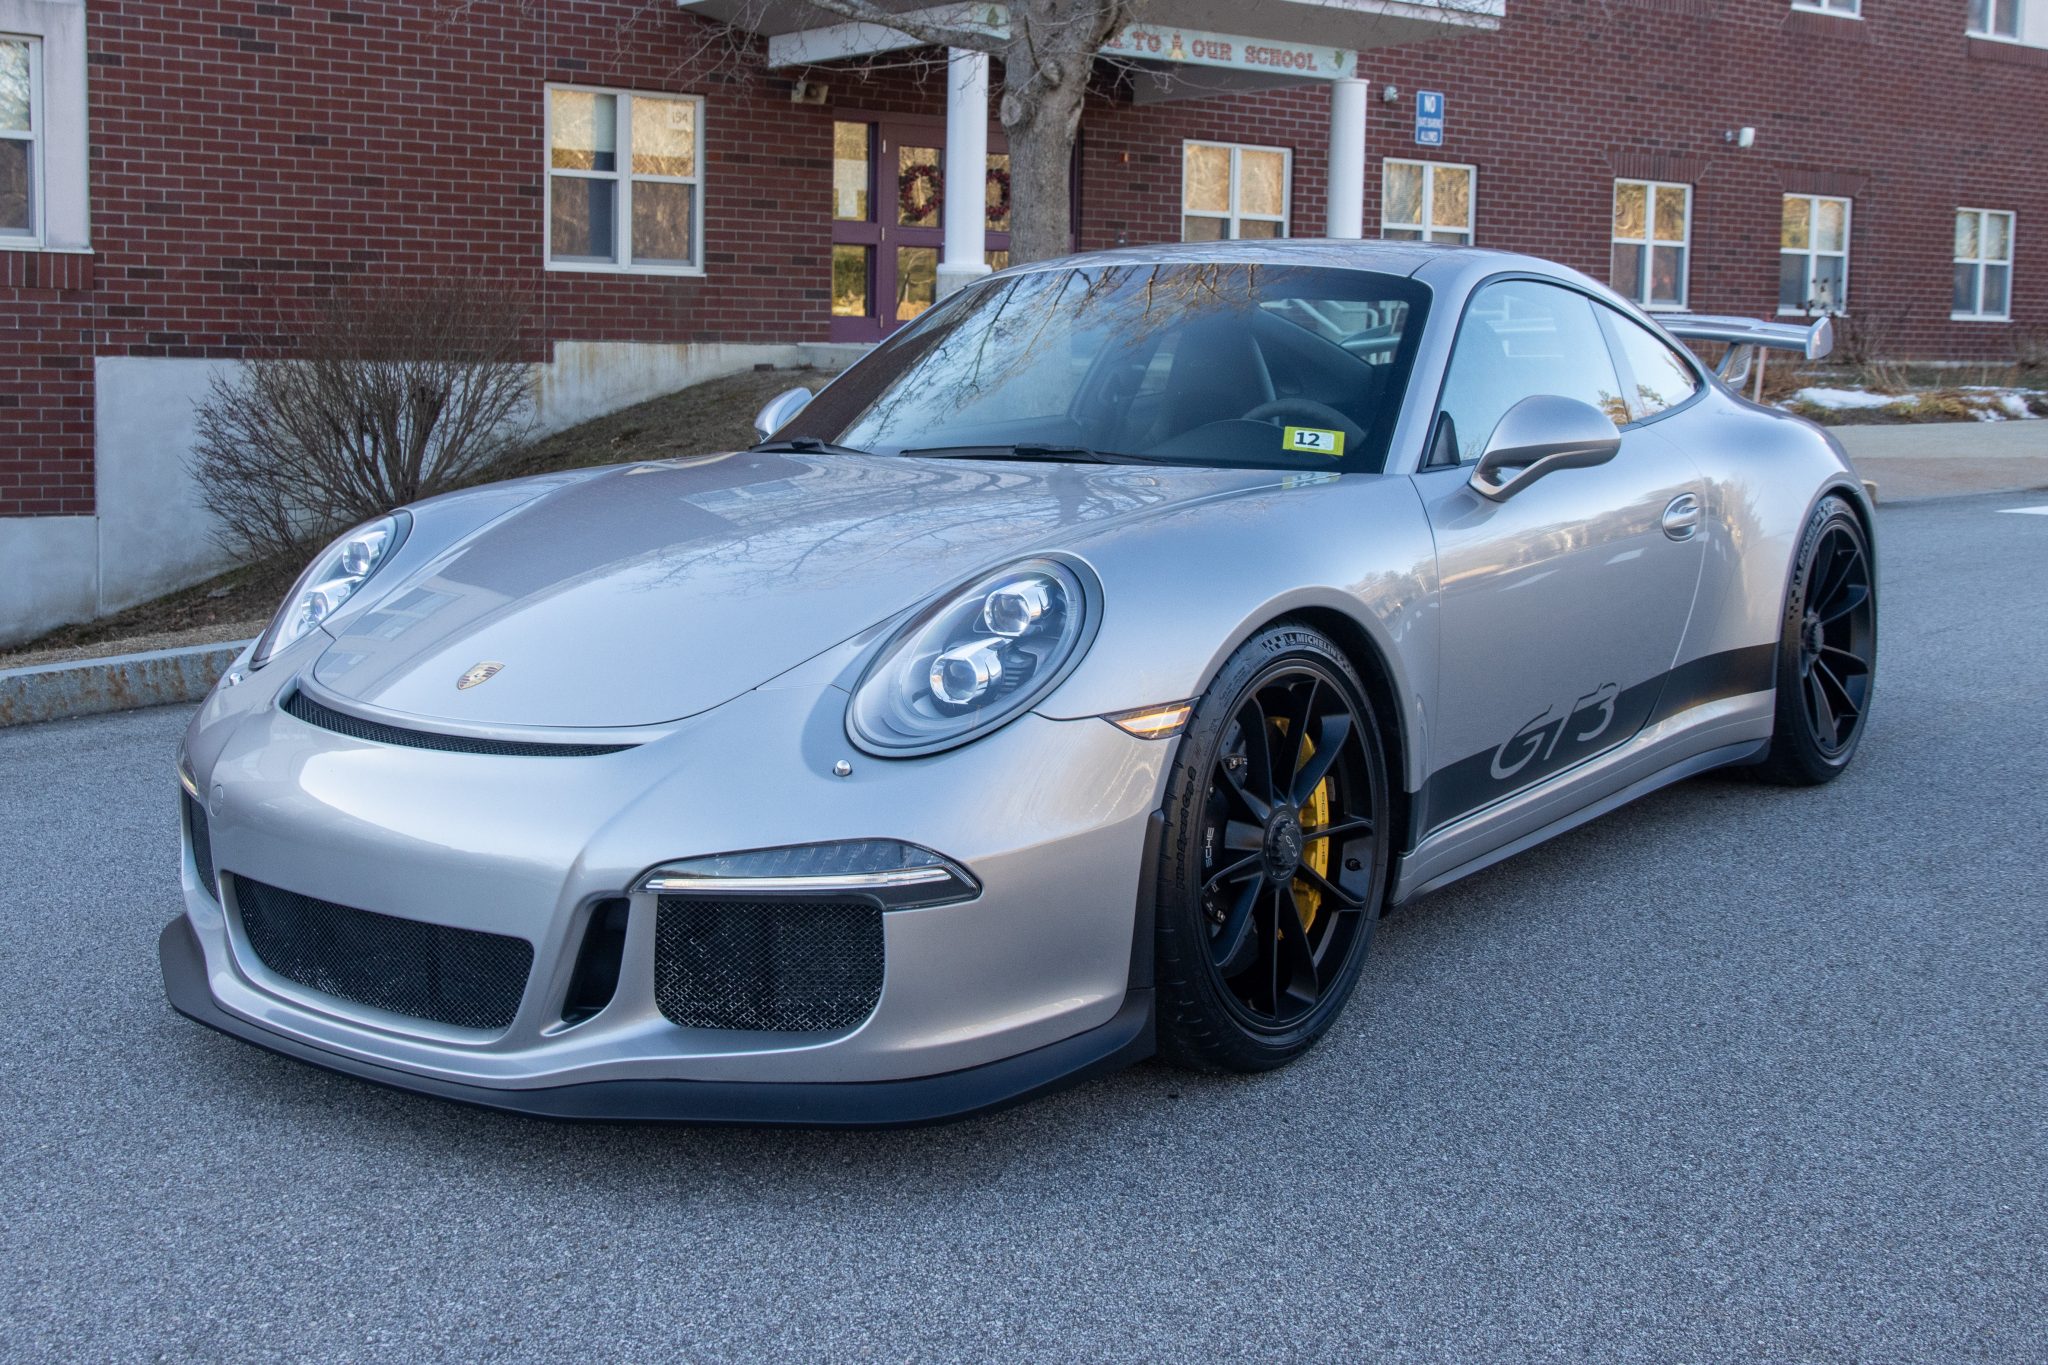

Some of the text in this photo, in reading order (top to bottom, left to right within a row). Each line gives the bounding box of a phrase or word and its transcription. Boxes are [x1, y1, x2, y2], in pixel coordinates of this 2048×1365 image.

[1132, 31, 1161, 53] TO
[1192, 39, 1232, 61] OUR
[1245, 45, 1317, 71] SCHOOL
[1424, 95, 1436, 112] NO
[1295, 432, 1320, 446] 12
[1296, 633, 1338, 659] MICHELIN
[1490, 682, 1622, 780] GT3
